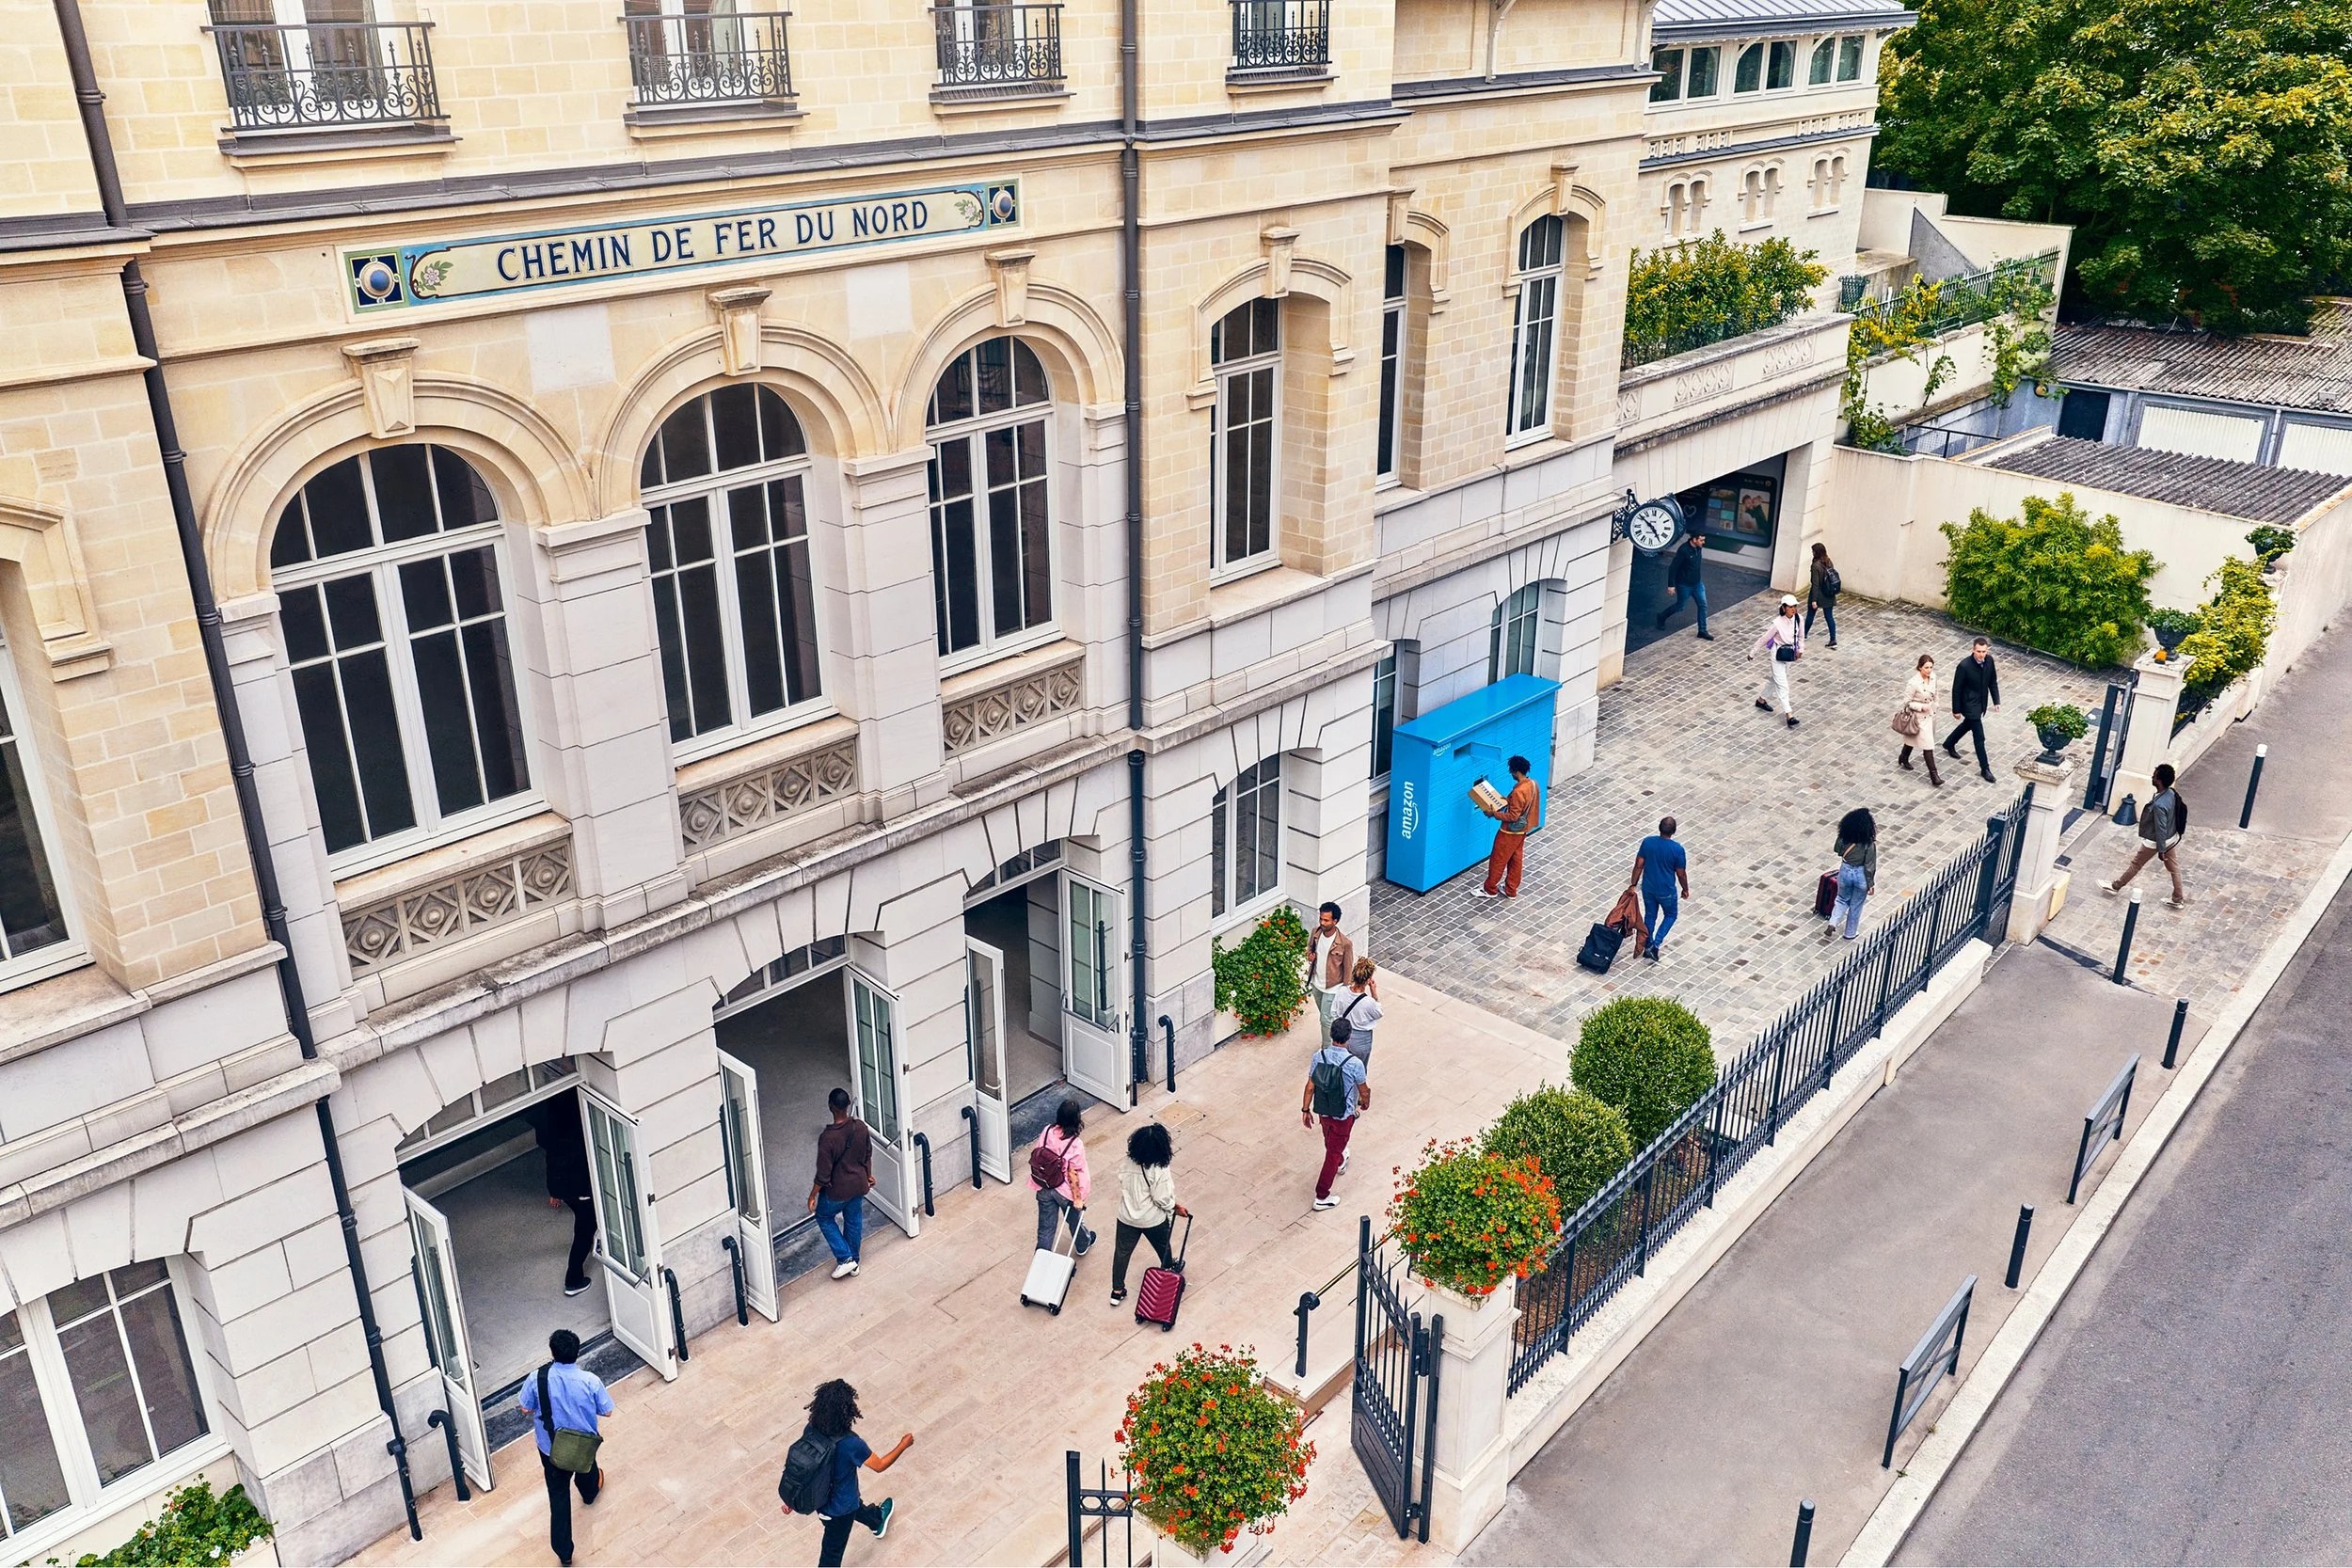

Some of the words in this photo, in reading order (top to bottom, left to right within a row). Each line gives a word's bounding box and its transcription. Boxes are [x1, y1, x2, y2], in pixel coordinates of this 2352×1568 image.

[497, 233, 632, 281] CHEMIN
[651, 227, 695, 262] DE
[714, 217, 778, 255] FER
[795, 210, 834, 245] DU
[851, 200, 929, 237] NORD
[1402, 781, 1414, 839] amazon
